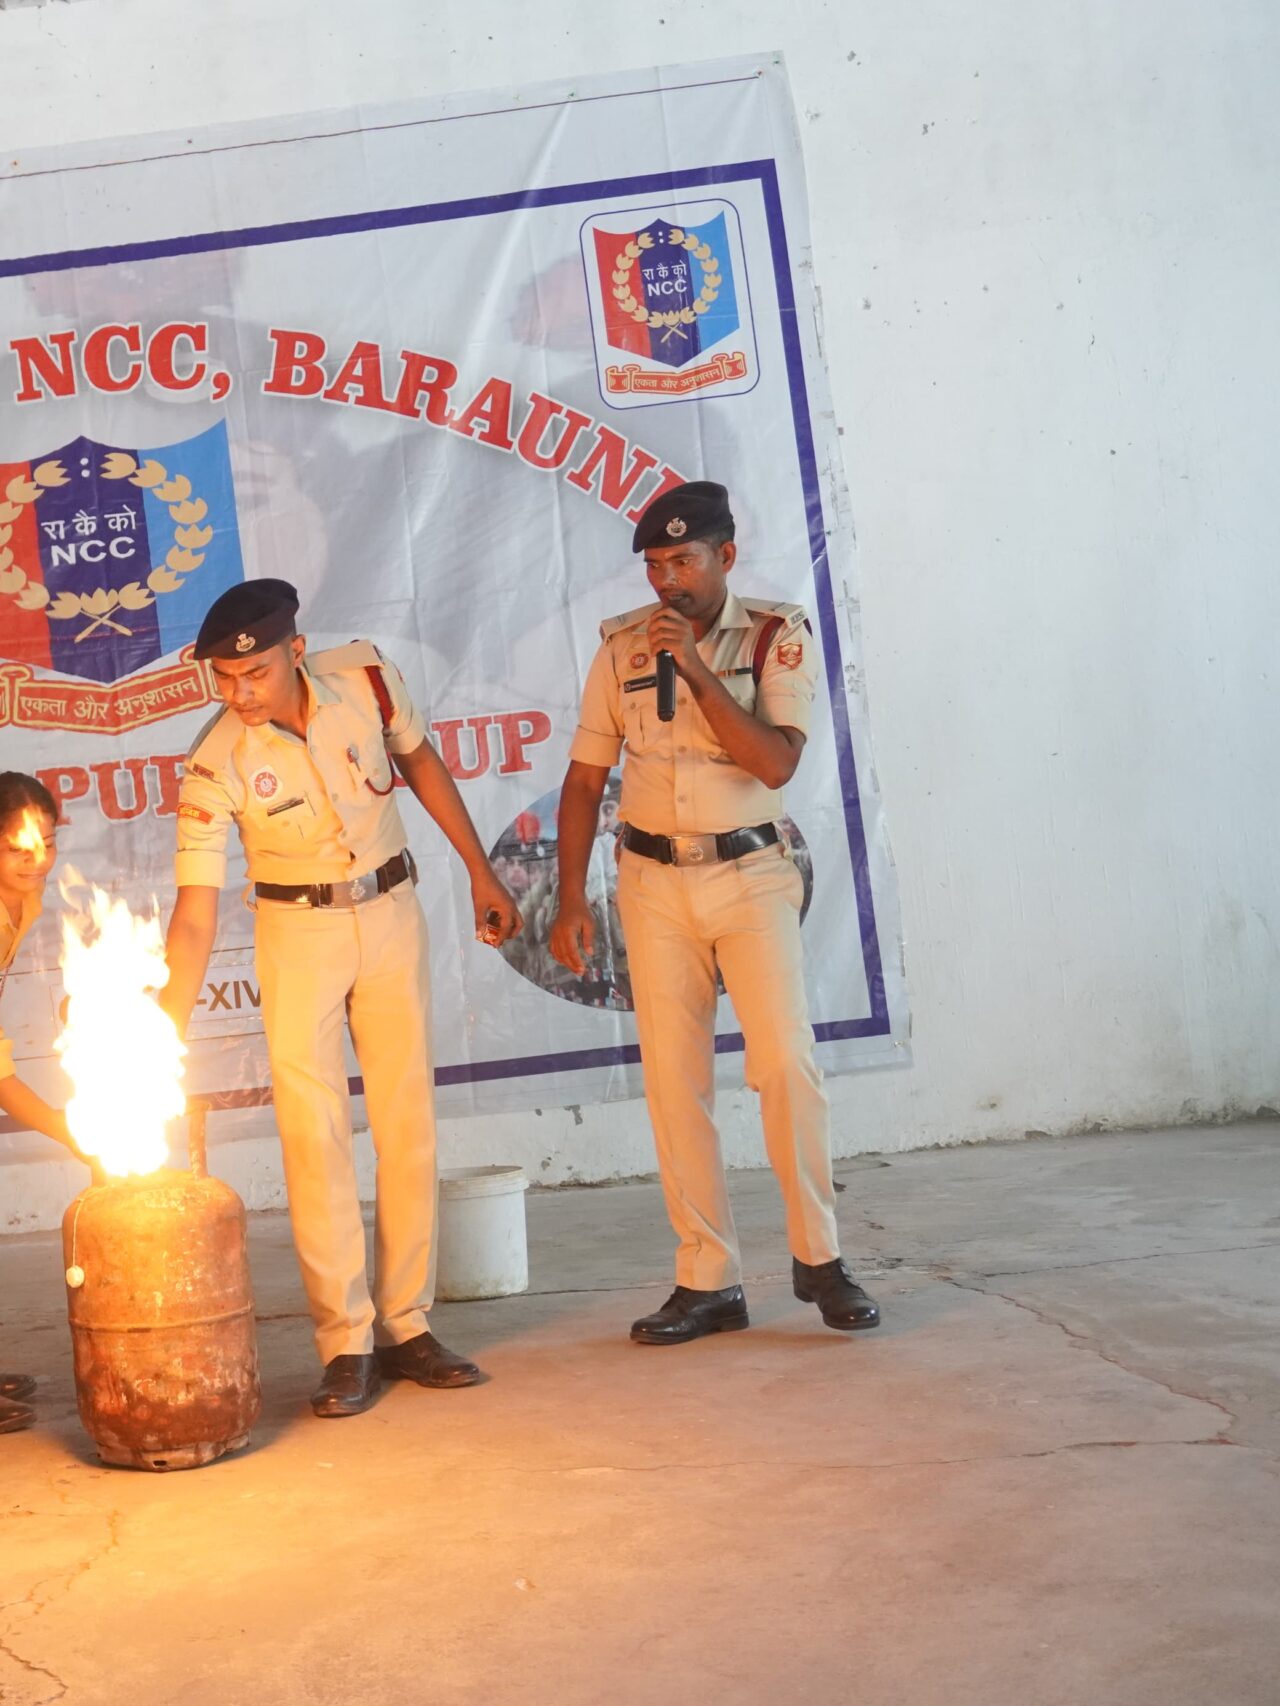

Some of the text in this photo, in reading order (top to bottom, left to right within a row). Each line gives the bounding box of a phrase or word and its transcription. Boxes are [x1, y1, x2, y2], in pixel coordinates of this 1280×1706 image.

[642, 260, 688, 281] रा कै को
[647, 279, 688, 297] NCC
[9, 322, 232, 402] NCC,
[633, 367, 721, 389] एकता और अनुशासन
[41, 504, 138, 540] रा कै को
[50, 536, 137, 567] NCC
[20, 676, 199, 720] एकता और अनुशासन
